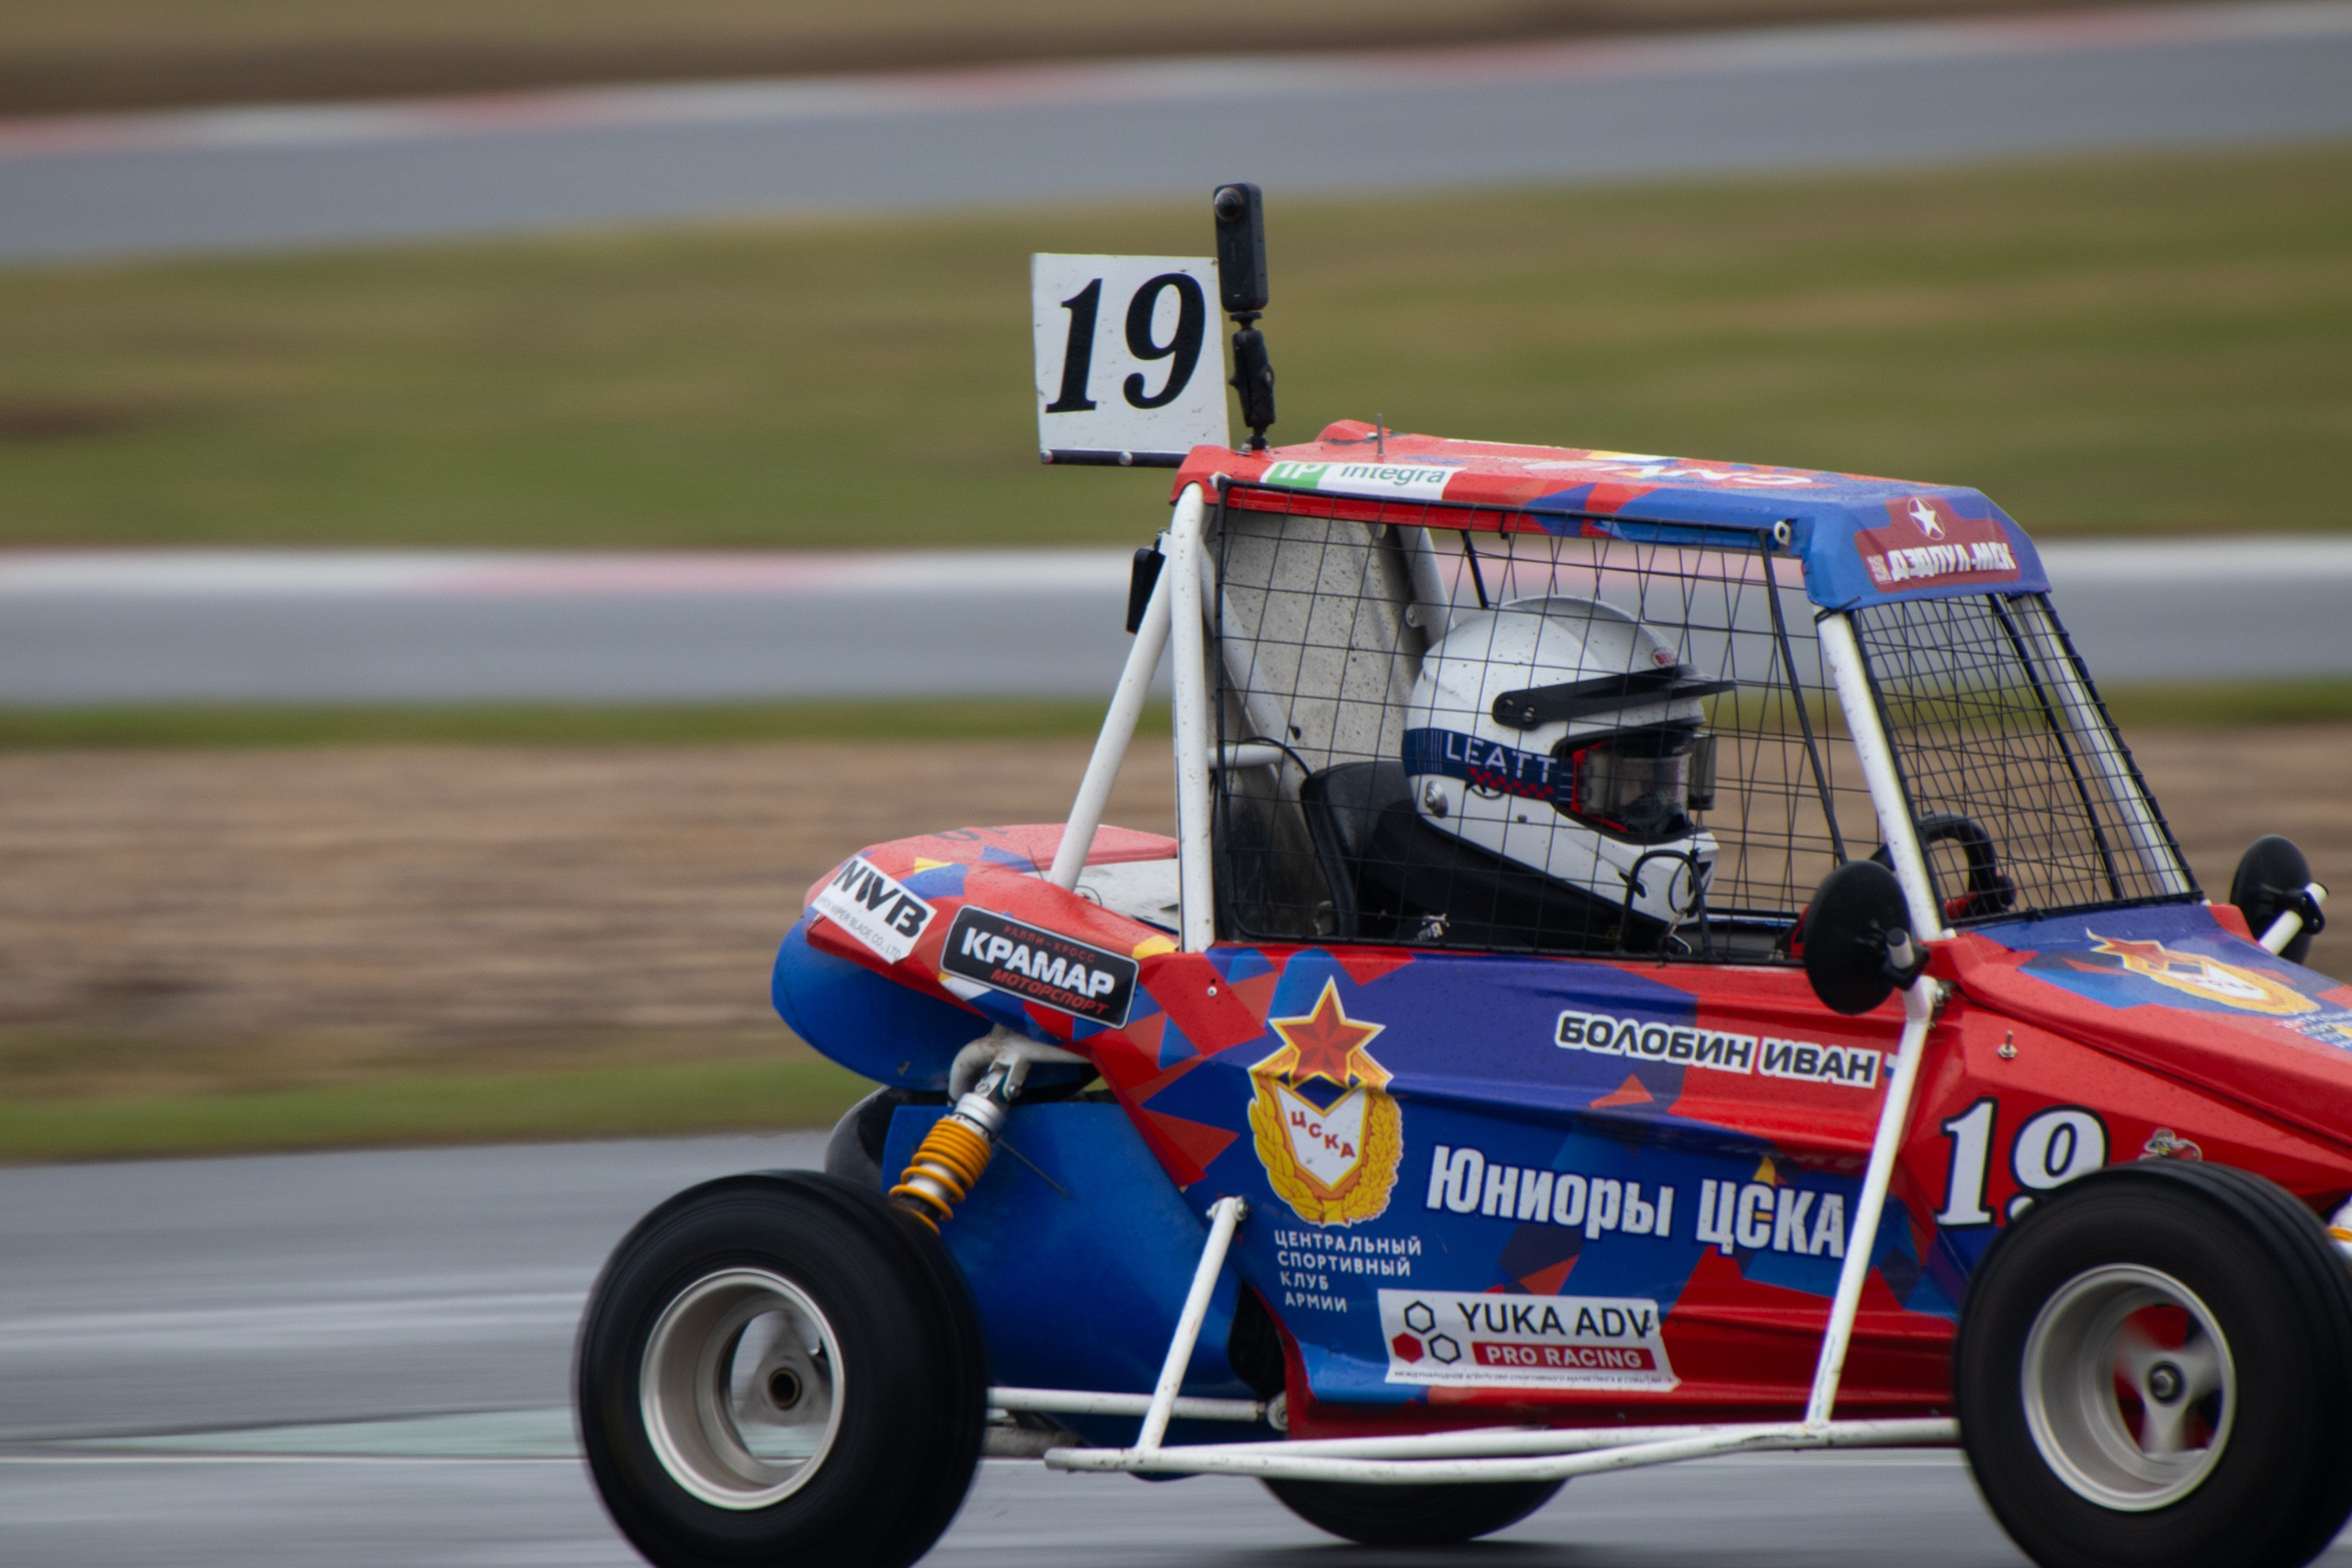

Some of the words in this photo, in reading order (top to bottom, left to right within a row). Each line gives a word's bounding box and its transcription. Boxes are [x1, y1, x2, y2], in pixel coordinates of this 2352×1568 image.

[1046, 273, 1205, 413] 19
[1340, 465, 1447, 486] integra
[1444, 732, 1557, 783] LEATT
[832, 860, 928, 938] NWB
[961, 927, 1115, 998] КРАМАР
[990, 968, 1110, 1015] МОТОРСПОРТ
[1558, 1015, 1754, 1069] БОЛОБИН
[1761, 1042, 1877, 1084] ИВАН
[1291, 1111, 1356, 1159] ЦСКА
[1934, 1097, 2110, 1227] 19
[1426, 1145, 1674, 1240] Юниоры
[1695, 1178, 1846, 1258] ЦСКА
[1274, 1229, 1421, 1257] ЦЕНТРАЛЬНЫЙ
[1277, 1250, 1411, 1277] СПОРТИВНЫЙ
[1280, 1270, 1329, 1291] КЛУБ
[1285, 1291, 1348, 1314] АРМИИ
[1457, 1302, 1565, 1337] YUKA
[1485, 1345, 1537, 1366] PRO
[1544, 1348, 1643, 1369] RACING
